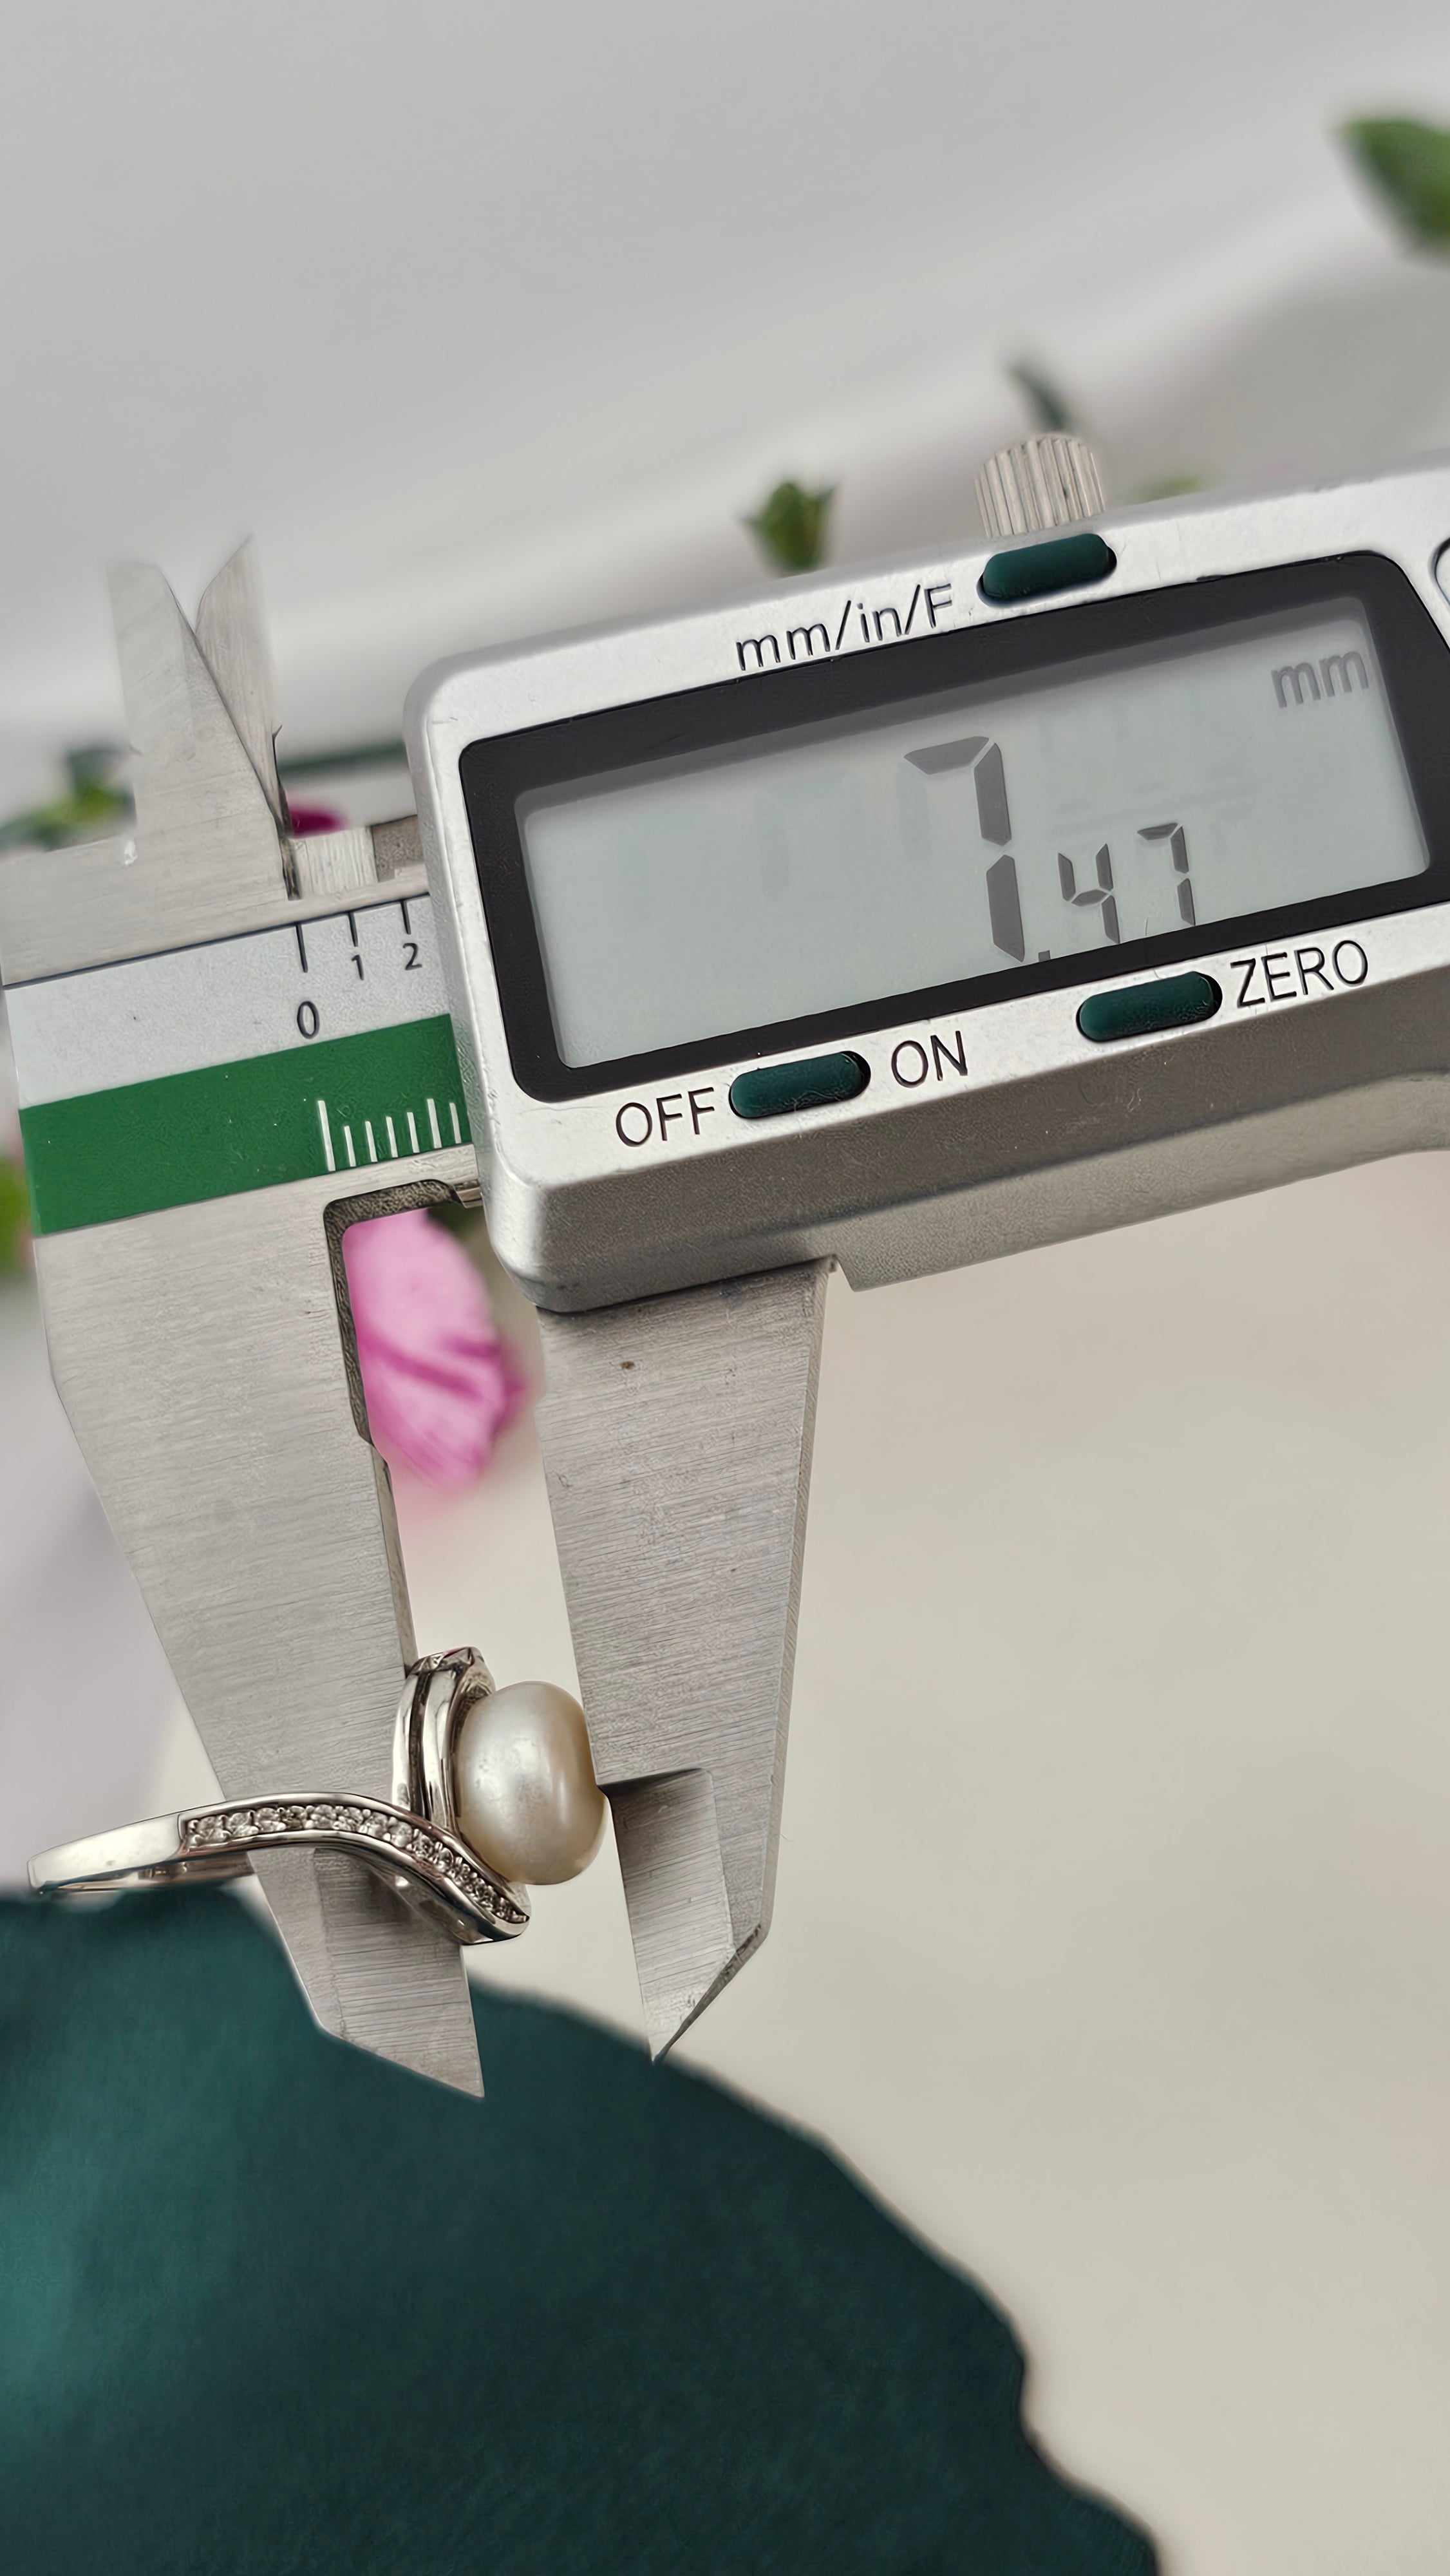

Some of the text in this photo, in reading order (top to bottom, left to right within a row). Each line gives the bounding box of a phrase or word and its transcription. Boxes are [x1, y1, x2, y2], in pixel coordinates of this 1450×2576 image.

[735, 583, 953, 671] mm/in/F
[1271, 650, 1370, 708] mm
[904, 735, 1196, 963] 7.47
[351, 942, 422, 981] 1 2
[1229, 939, 1370, 1009] ZERO
[296, 1000, 320, 1039] 0
[890, 1030, 969, 1088] ON
[615, 1086, 715, 1148] OFF
